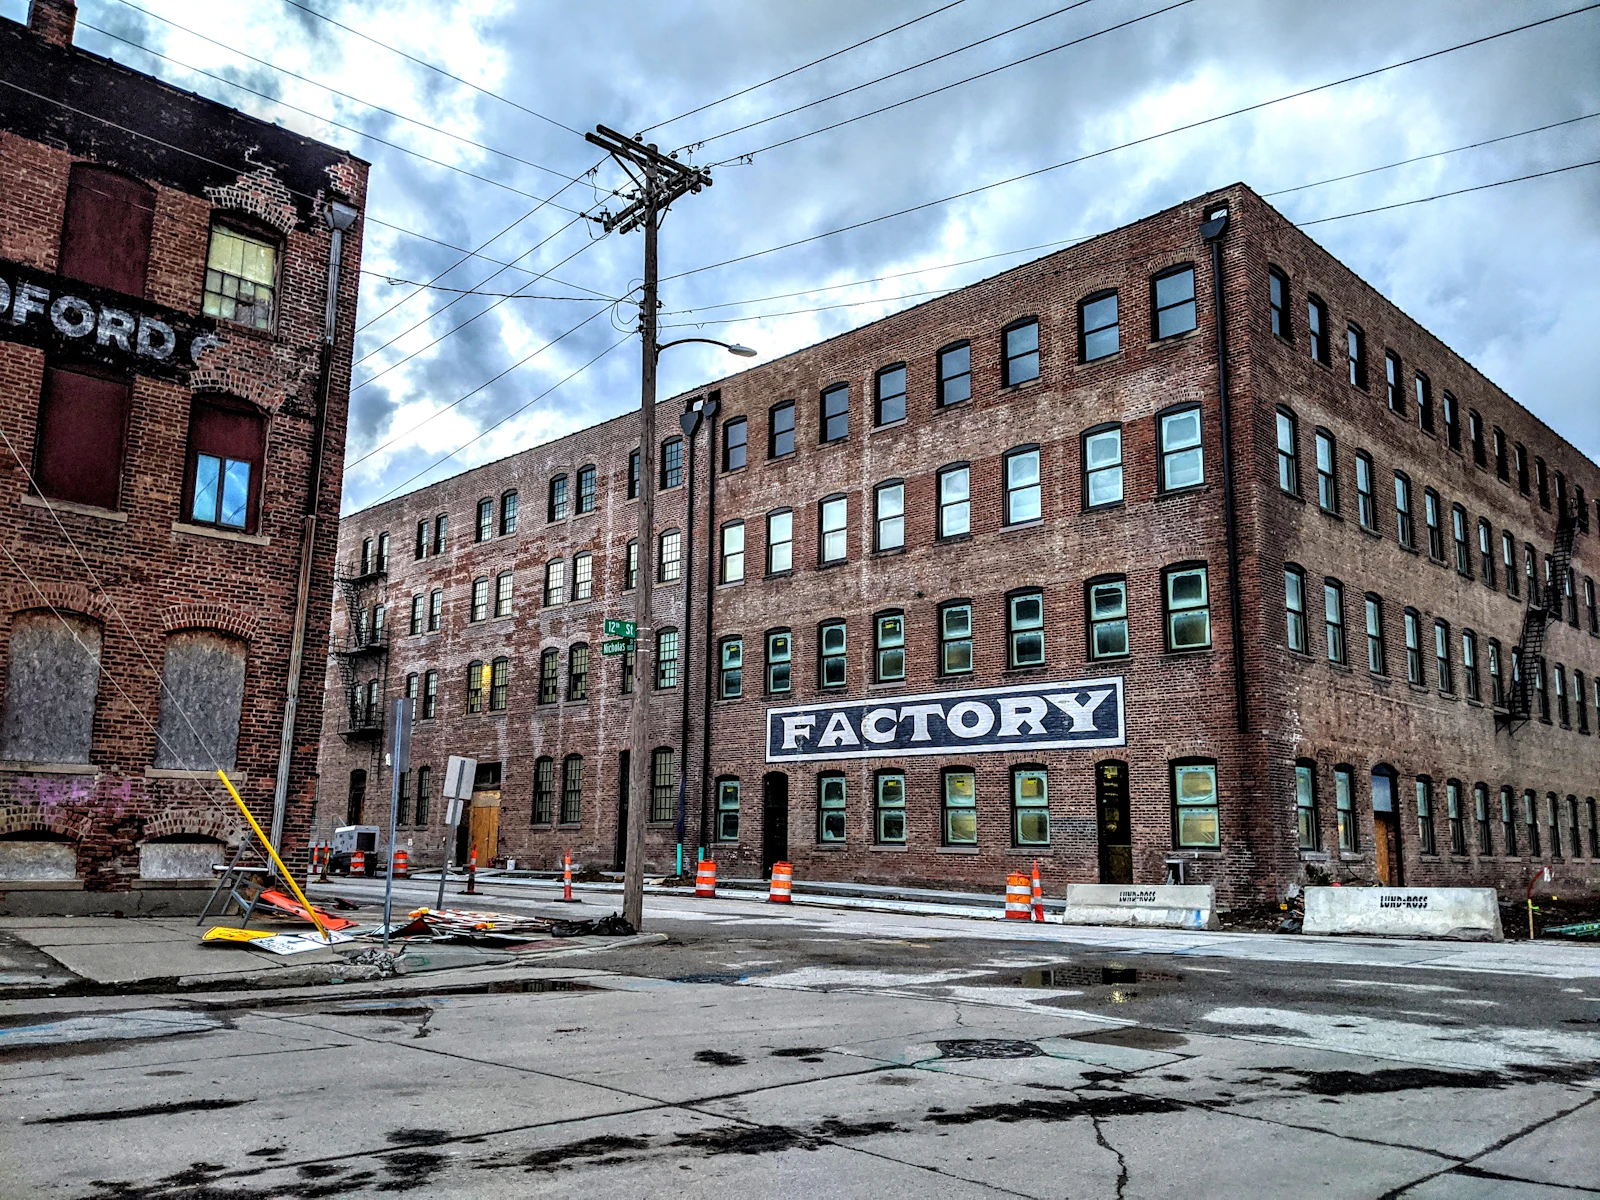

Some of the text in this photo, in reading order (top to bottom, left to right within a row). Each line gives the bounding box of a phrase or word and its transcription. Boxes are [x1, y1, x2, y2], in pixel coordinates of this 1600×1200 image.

[0, 277, 176, 360] FORD
[626, 624, 633, 635] St
[604, 642, 625, 654] Nicholas
[781, 689, 1114, 750] FACTORY
